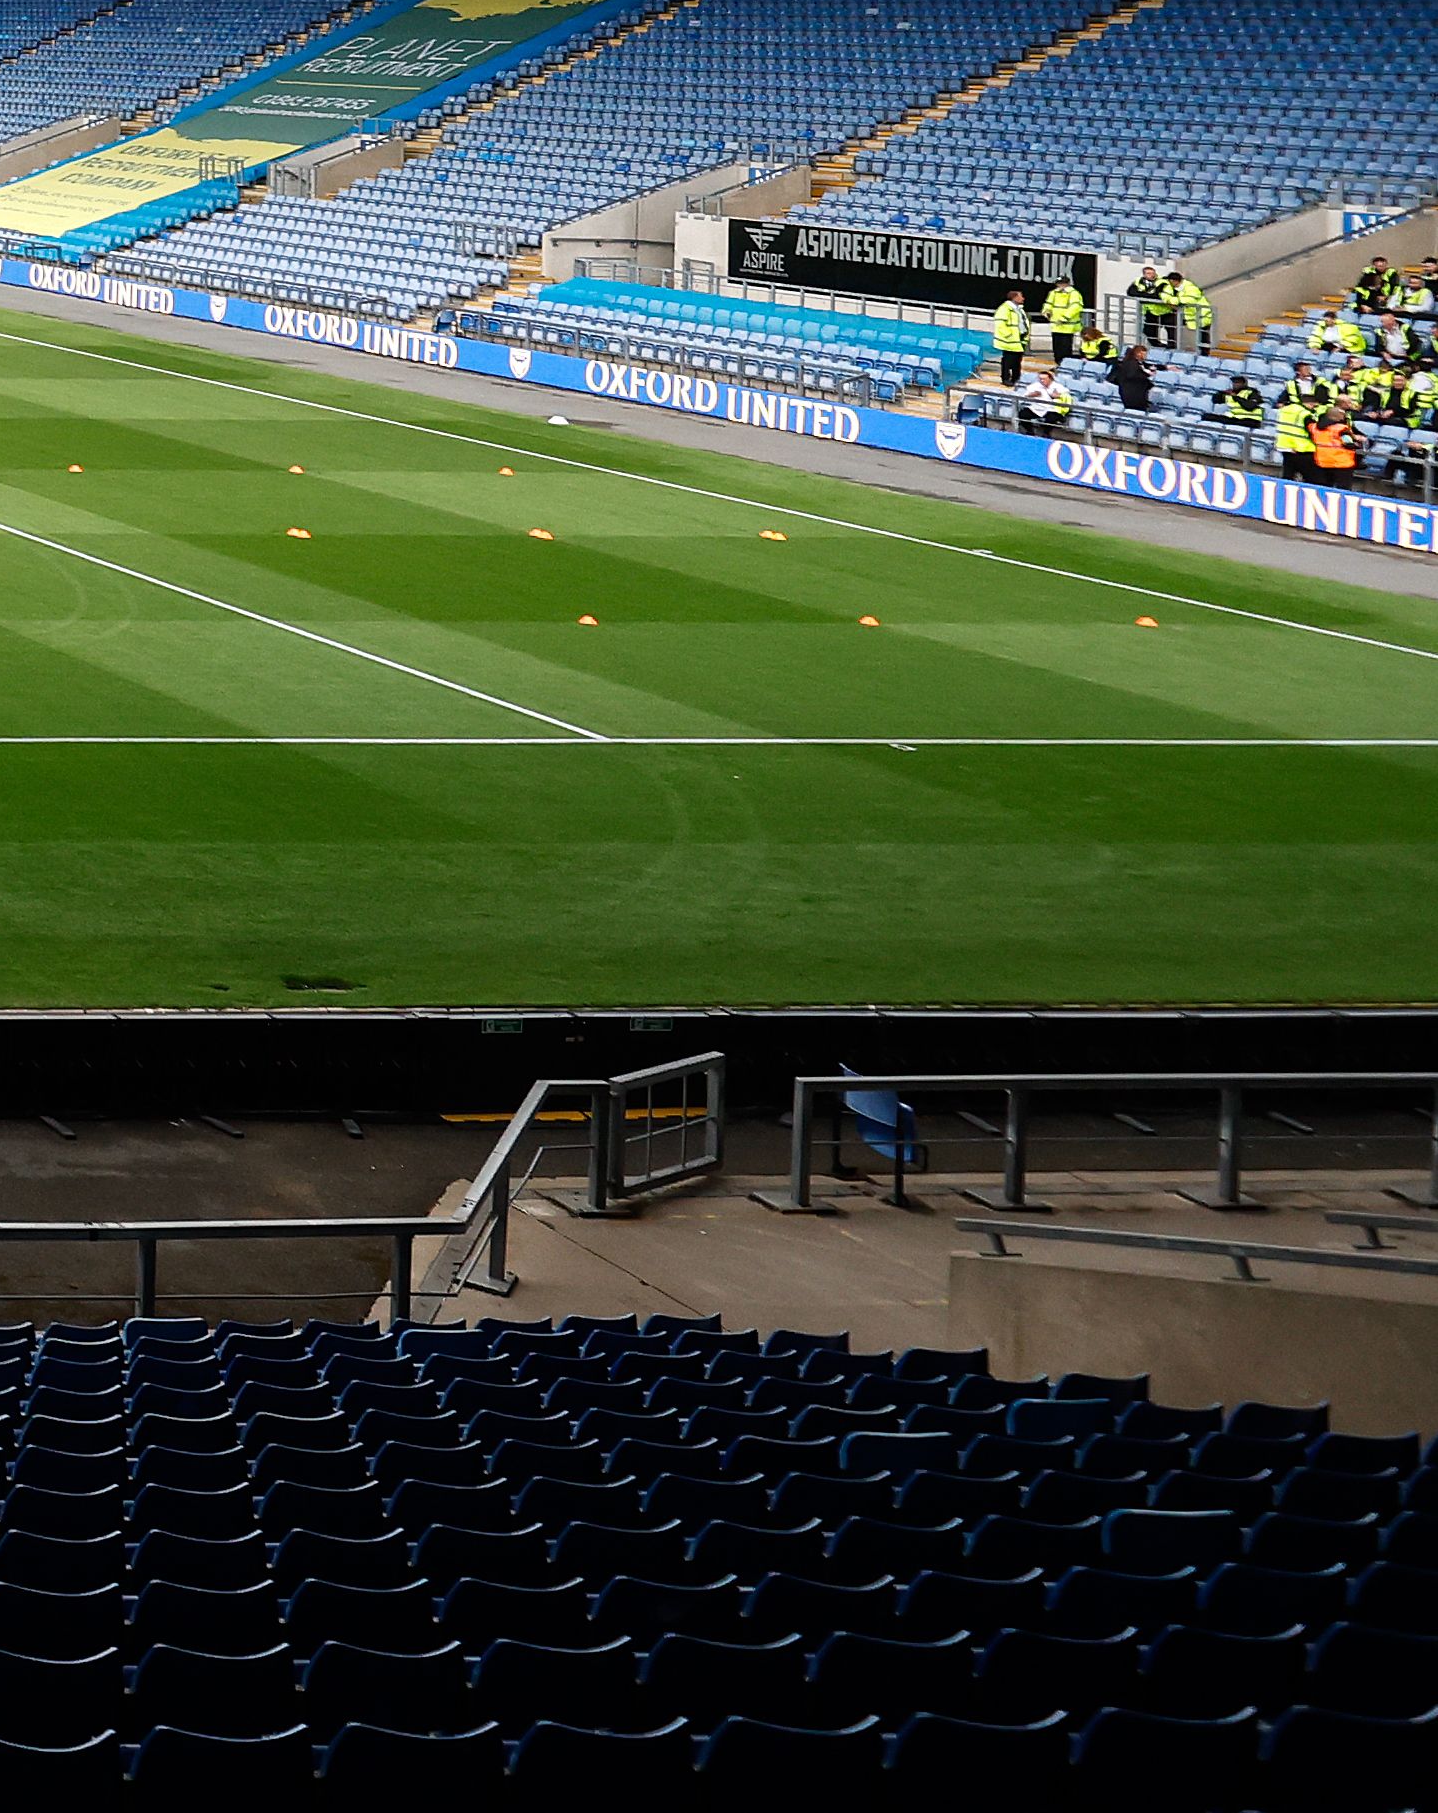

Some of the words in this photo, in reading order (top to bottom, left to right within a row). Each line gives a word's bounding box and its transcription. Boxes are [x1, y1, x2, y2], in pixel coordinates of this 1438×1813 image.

[296, 58, 468, 78] RECRUITMENT
[324, 36, 513, 62] PLANET
[742, 250, 785, 272] ASPIRE
[794, 227, 1076, 286] ASPIRESCAFFOLDING.CO.UK
[29, 263, 101, 299] OXFORD
[103, 276, 174, 314] UNITED
[263, 304, 359, 347] OXFORD
[363, 323, 458, 369] UNITED
[585, 359, 719, 413] OXFORD
[726, 387, 861, 444] UNITED
[1047, 440, 1249, 511] OXFORD
[1261, 479, 1438, 553] UNITE
